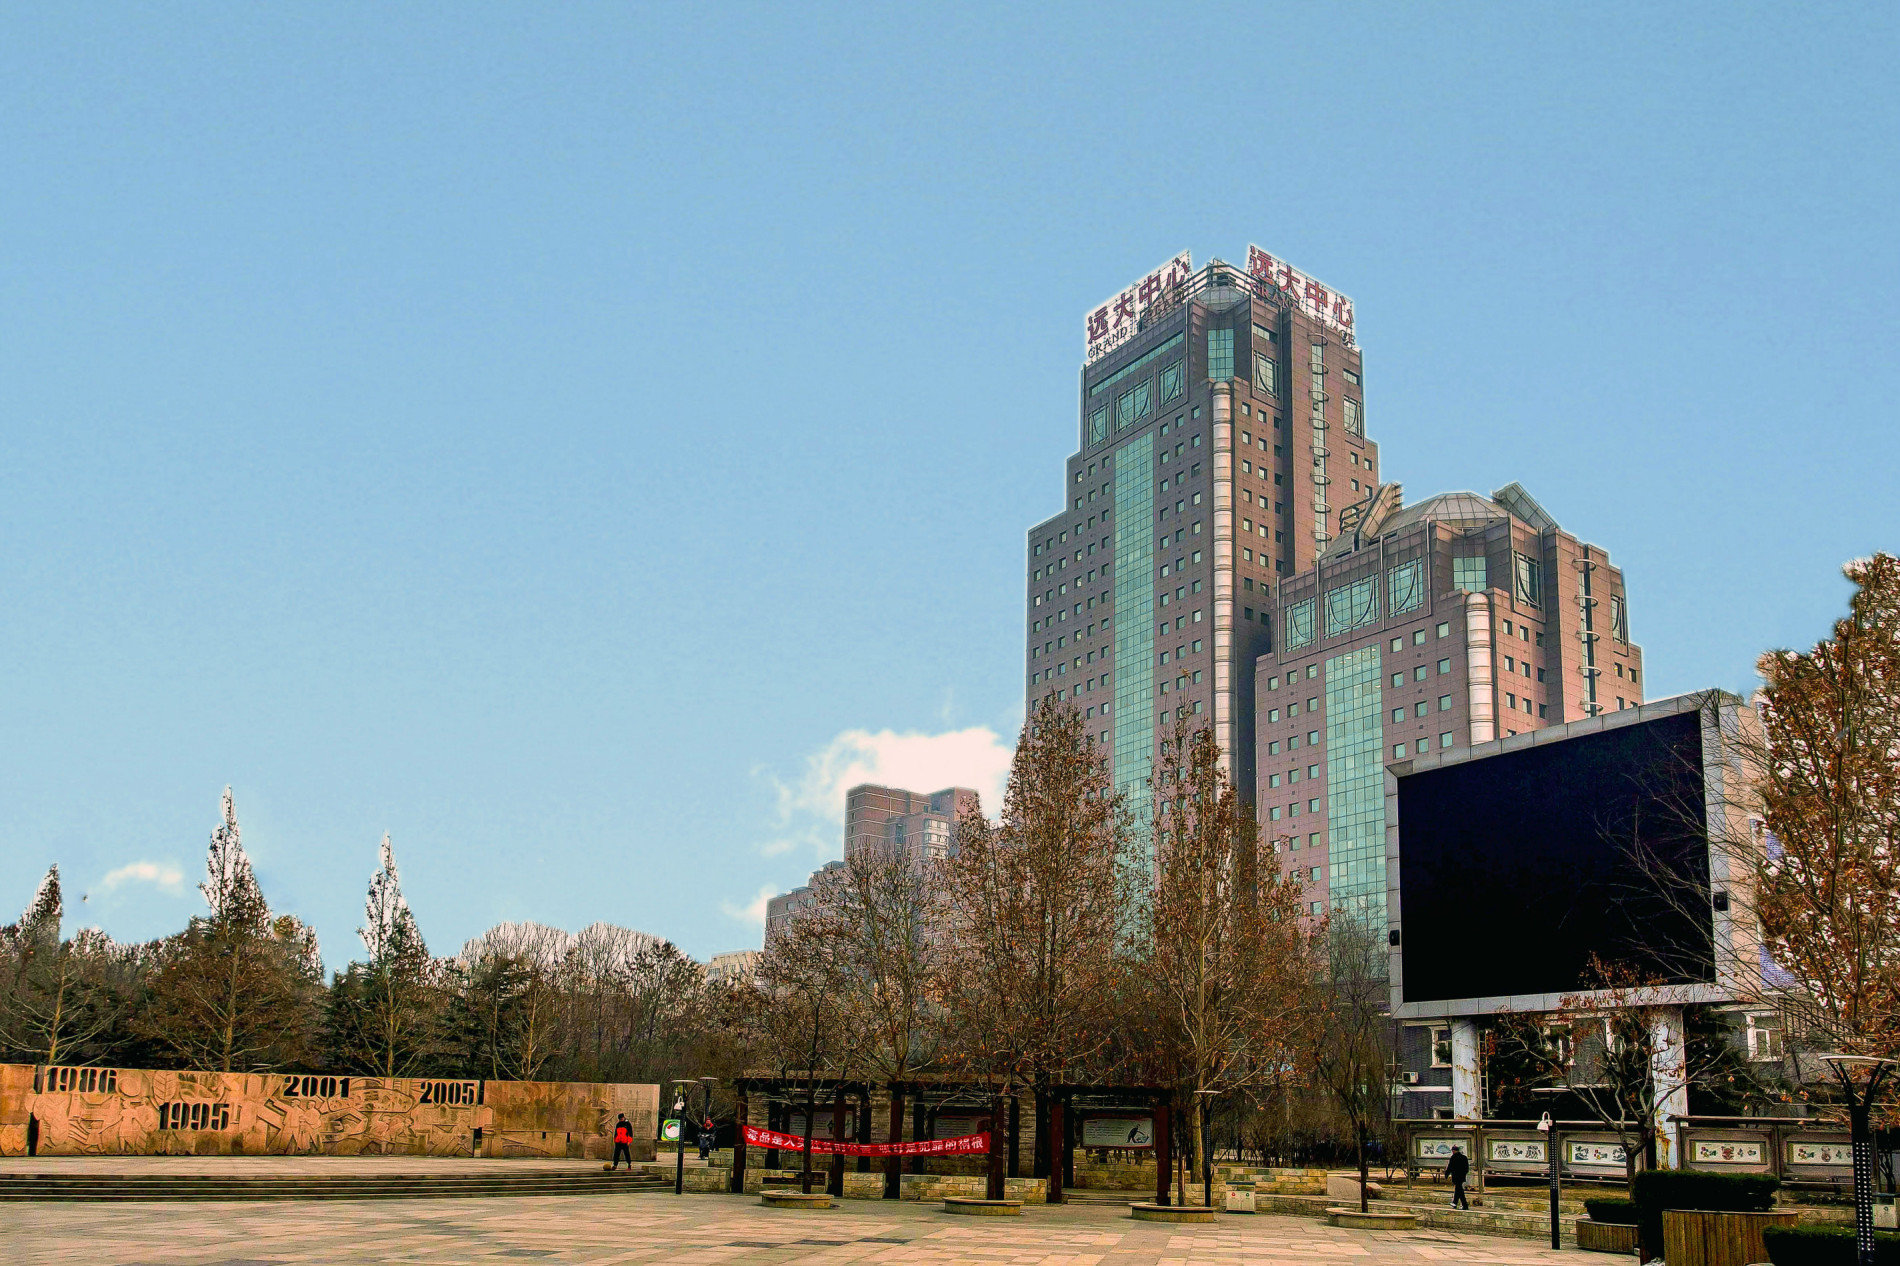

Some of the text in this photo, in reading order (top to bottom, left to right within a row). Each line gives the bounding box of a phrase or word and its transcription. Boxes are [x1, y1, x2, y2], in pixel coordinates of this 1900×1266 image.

[1087, 257, 1190, 345] 远大中心
[1250, 245, 1355, 328] 远大中心
[1088, 327, 1128, 358] GRAND
[47, 1067, 118, 1093] 1986
[284, 1076, 350, 1098] 2001
[420, 1081, 475, 1105] 2005
[159, 1102, 230, 1131] 1995
